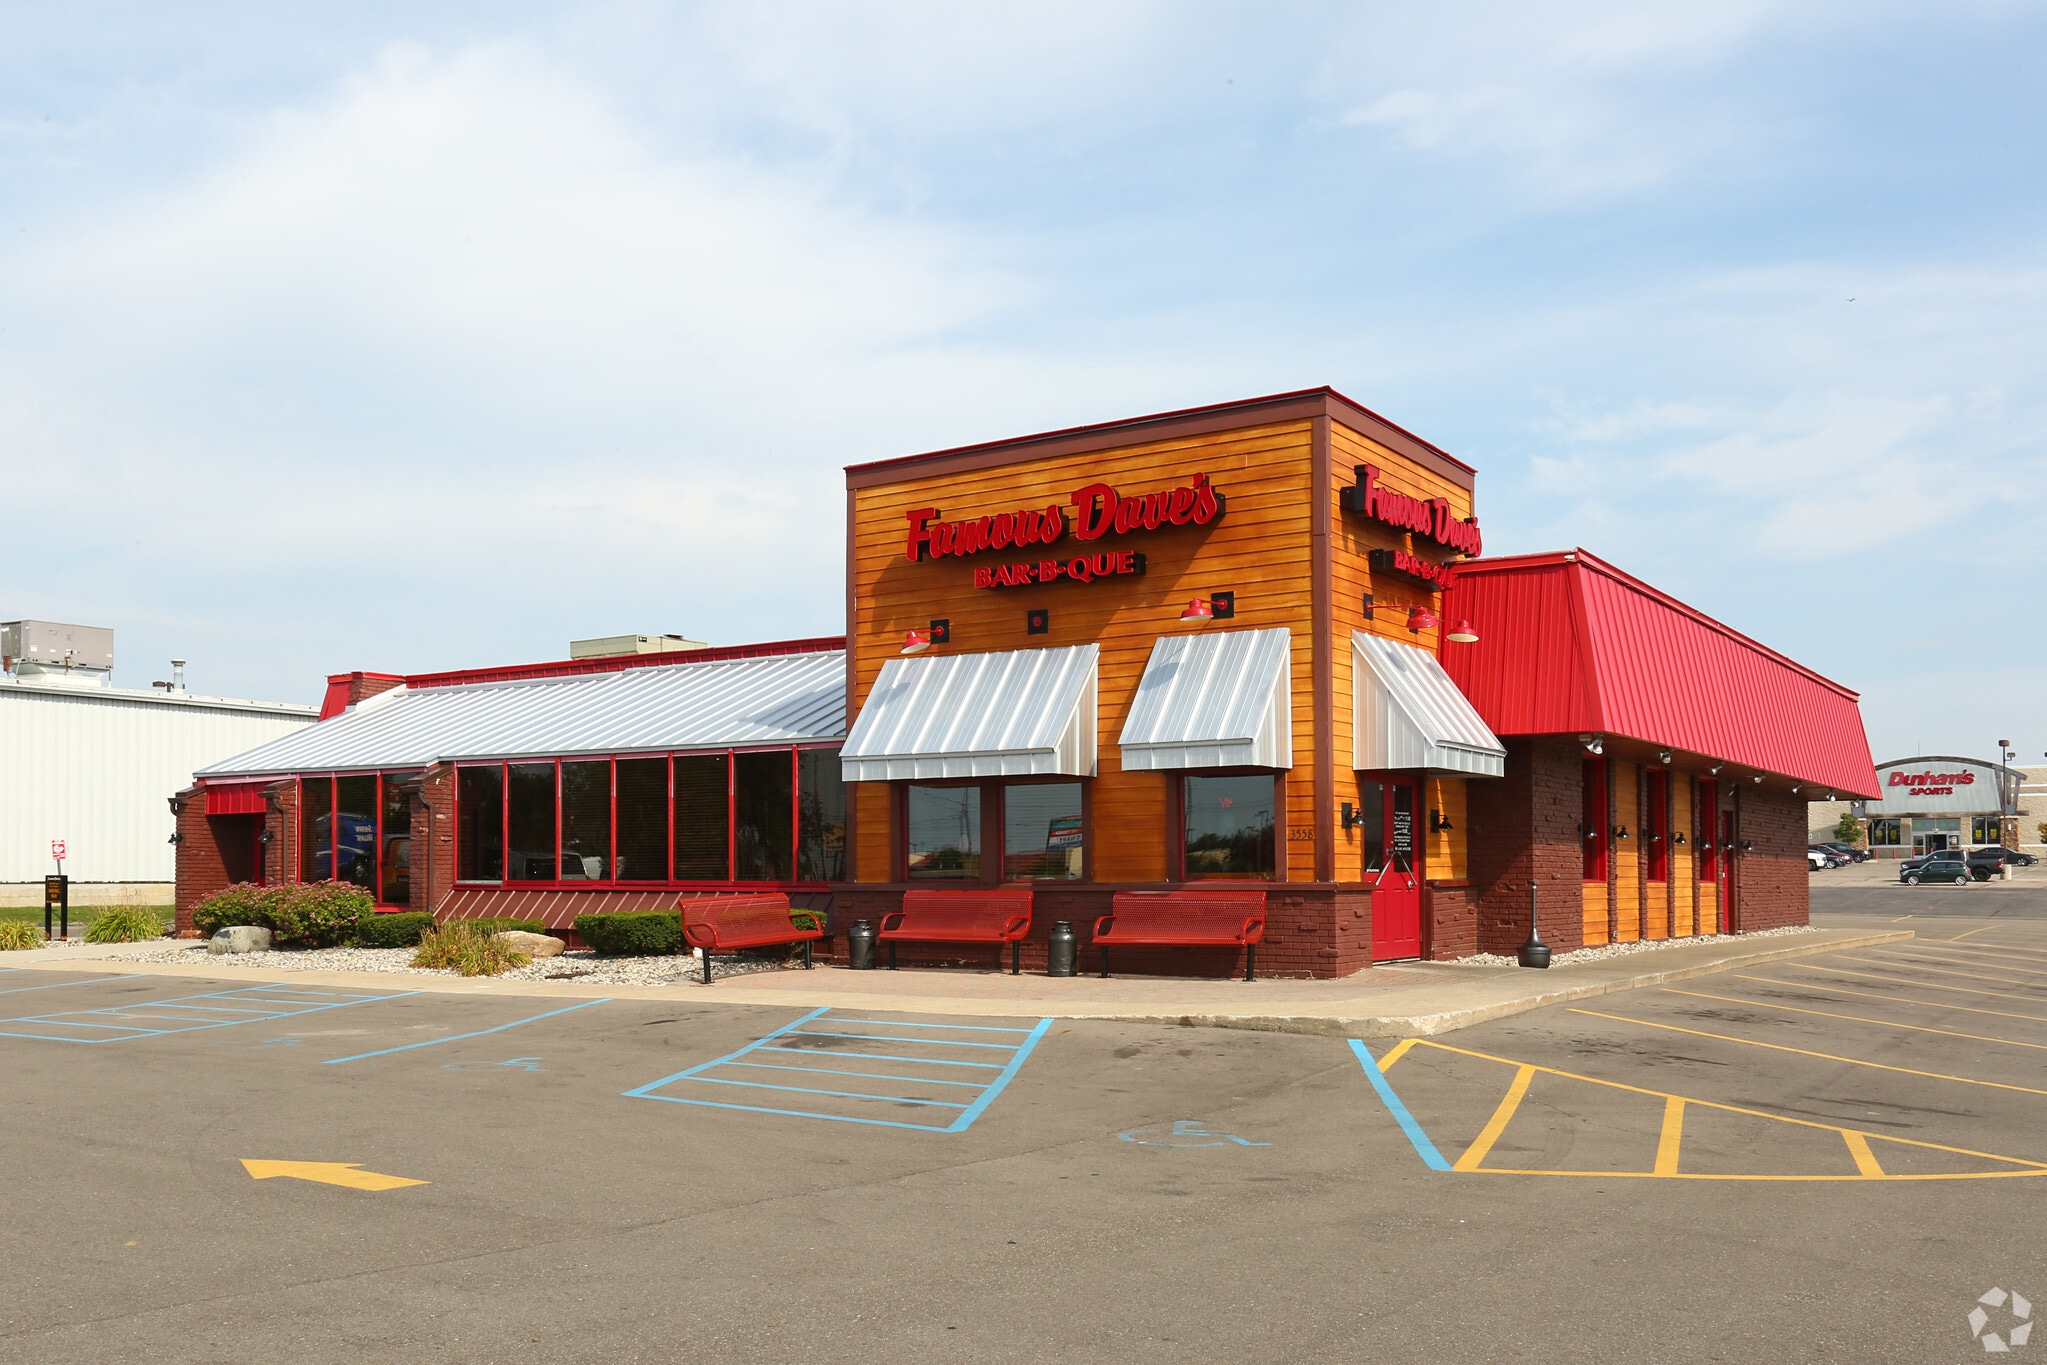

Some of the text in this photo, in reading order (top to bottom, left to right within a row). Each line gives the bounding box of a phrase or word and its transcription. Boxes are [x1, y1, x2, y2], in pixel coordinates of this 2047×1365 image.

[1364, 463, 1433, 536] Famous
[906, 472, 1222, 562] Famous Dave's
[1889, 769, 1975, 786] Dunham's
[1909, 787, 1953, 796] SPORTS
[1290, 829, 1314, 840] 3558
